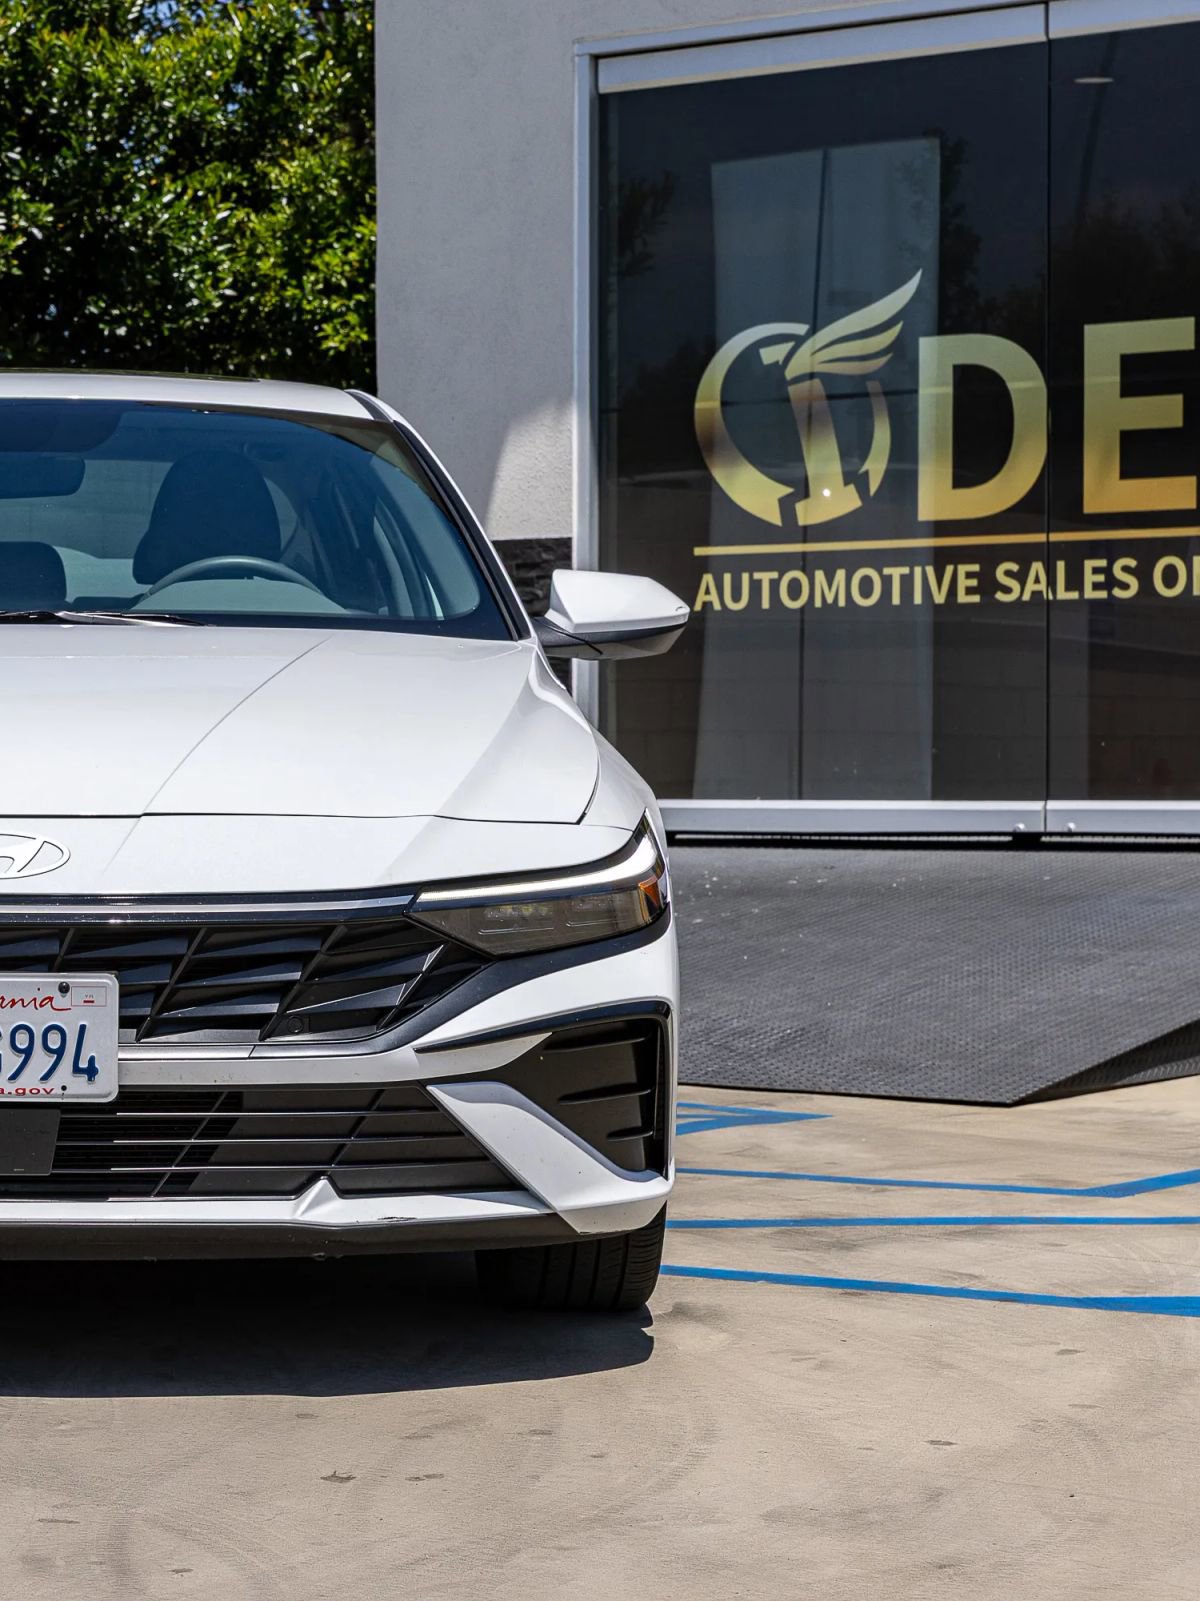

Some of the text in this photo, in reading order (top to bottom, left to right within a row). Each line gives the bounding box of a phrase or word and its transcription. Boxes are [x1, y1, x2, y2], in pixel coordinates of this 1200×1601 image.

[694, 554, 1200, 611] AUTOMOTIVE SALES O
